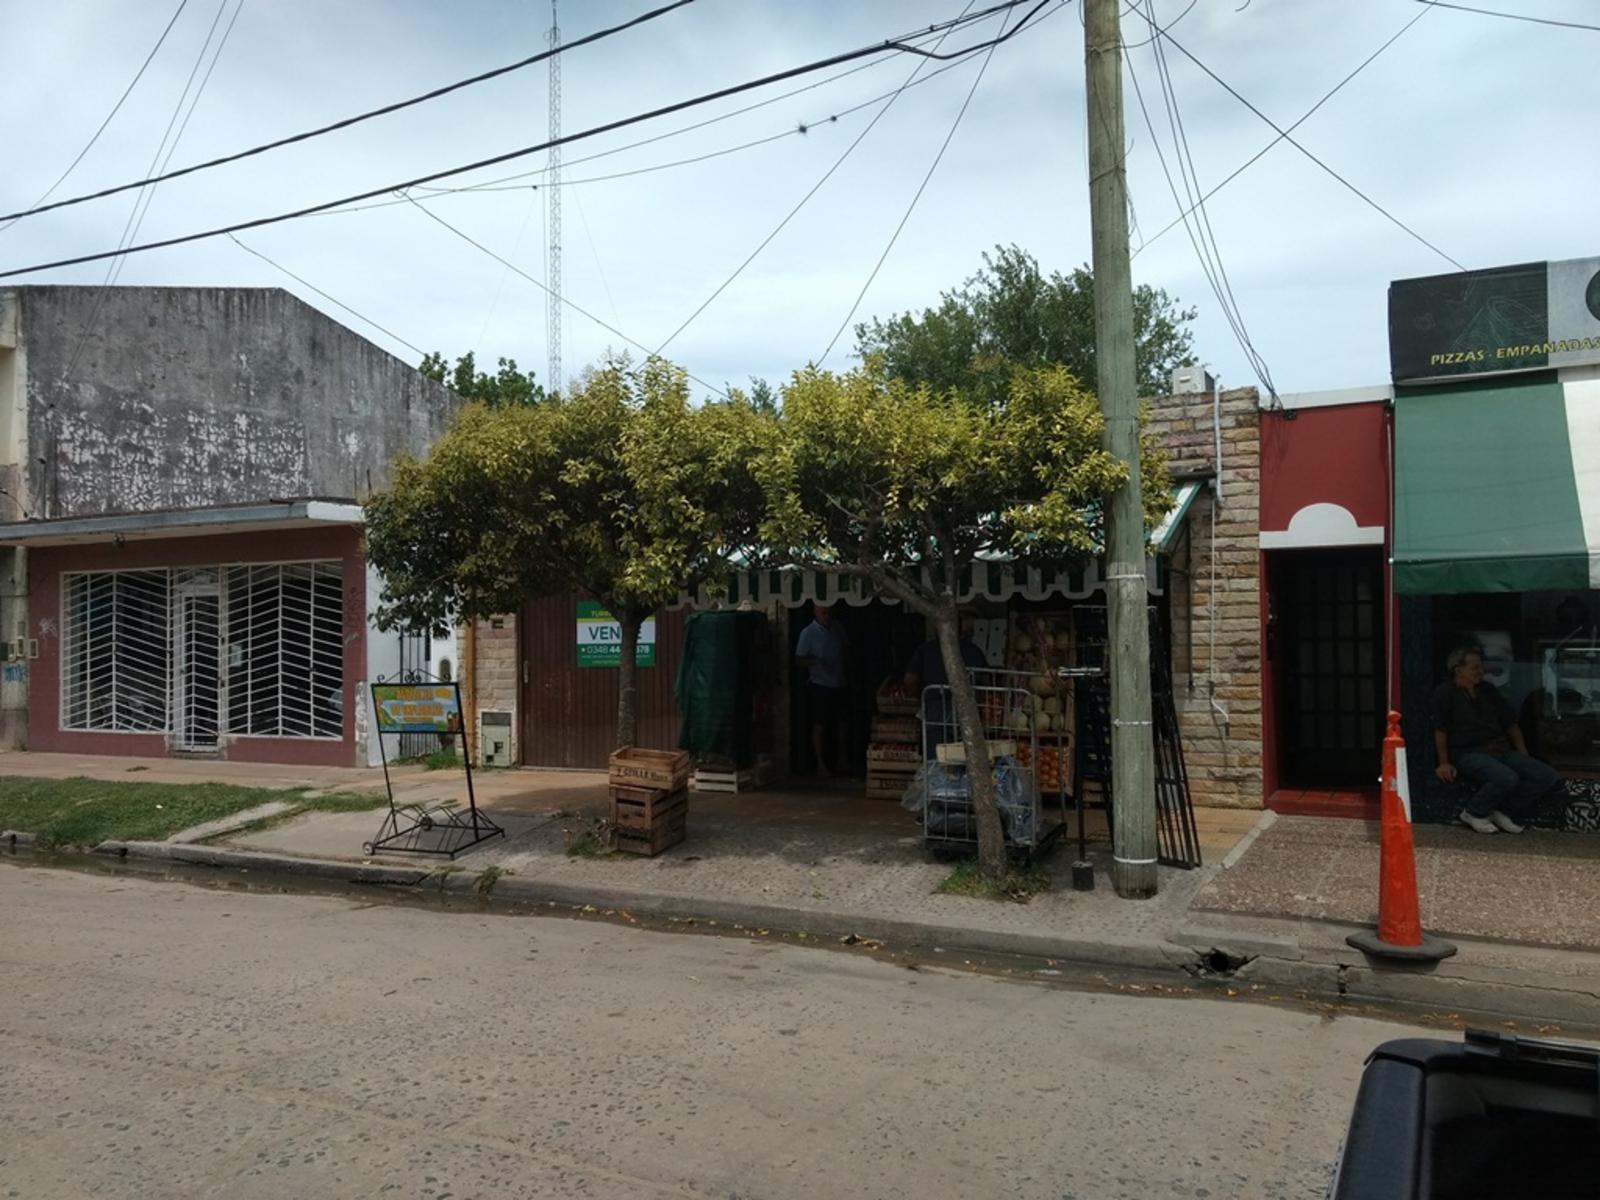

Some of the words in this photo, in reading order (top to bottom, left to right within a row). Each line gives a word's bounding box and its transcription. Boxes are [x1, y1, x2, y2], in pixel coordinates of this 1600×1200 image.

[1431, 350, 1484, 365] PIZZAS
[1497, 337, 1600, 358] EMPANADAS
[588, 626, 642, 640] VENE
